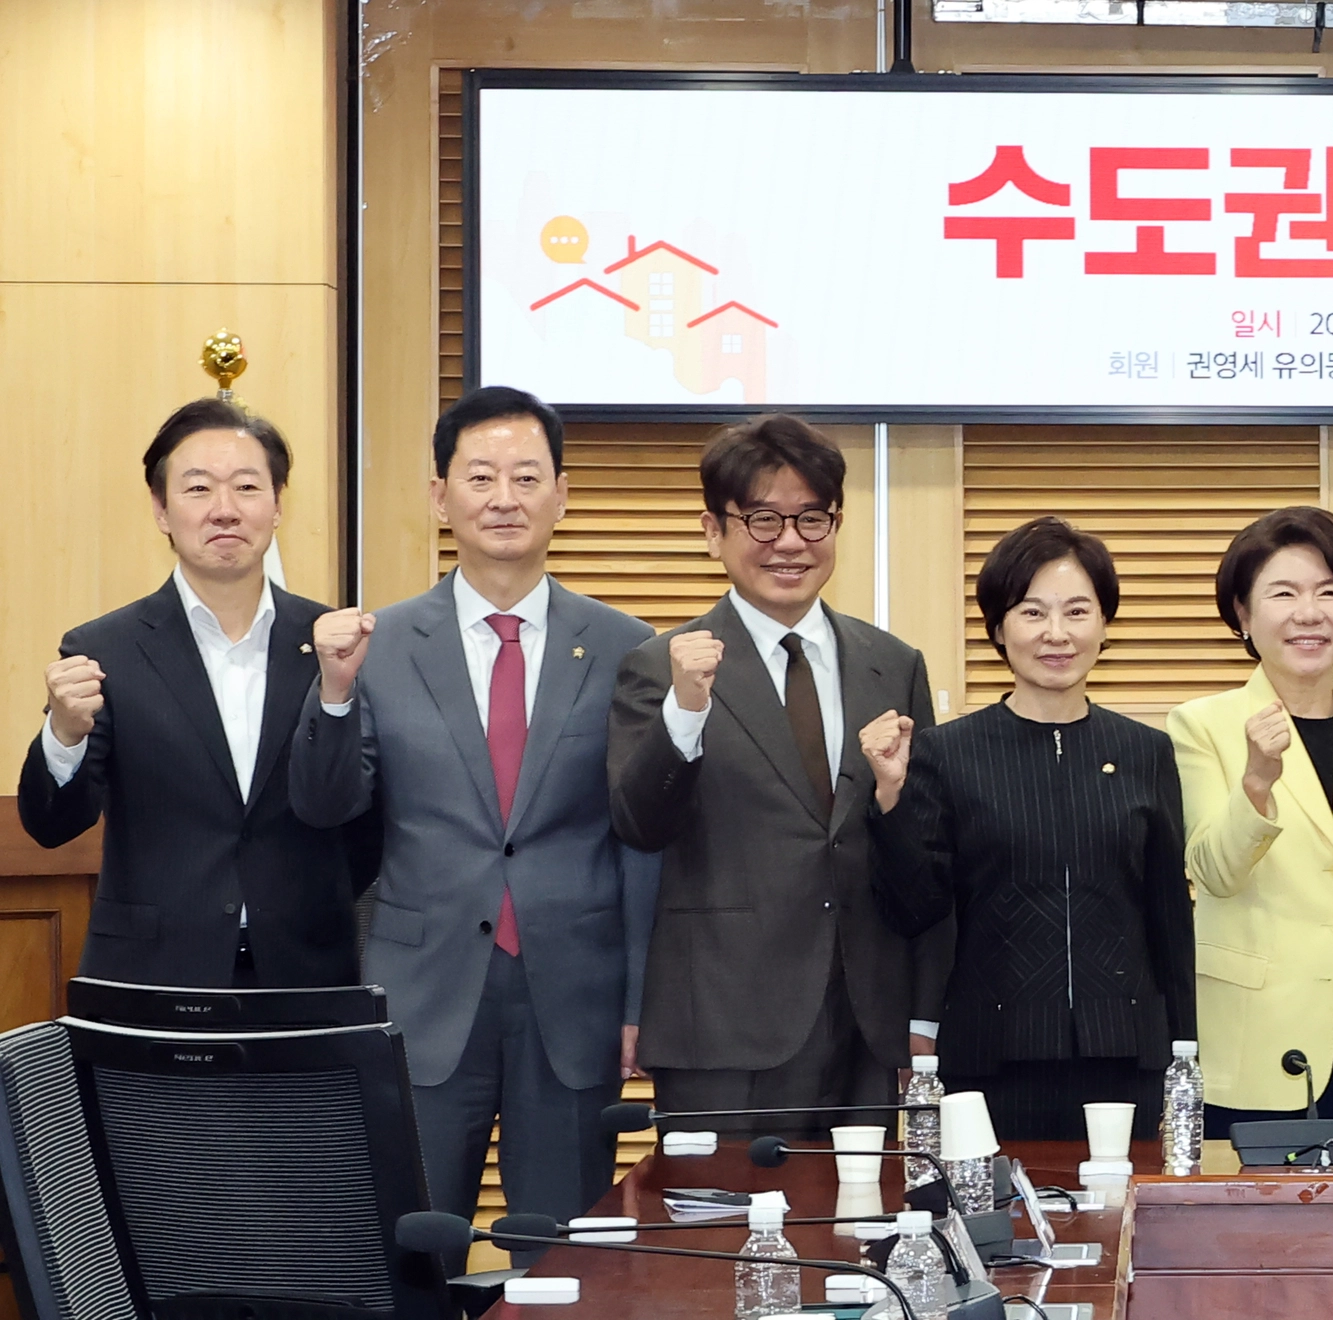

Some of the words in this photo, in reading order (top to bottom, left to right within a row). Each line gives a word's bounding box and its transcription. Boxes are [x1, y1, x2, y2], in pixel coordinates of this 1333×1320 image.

[1232, 310, 1280, 338] 일시
[1108, 351, 1158, 379] 회원
[1187, 351, 1263, 379] 권영세
